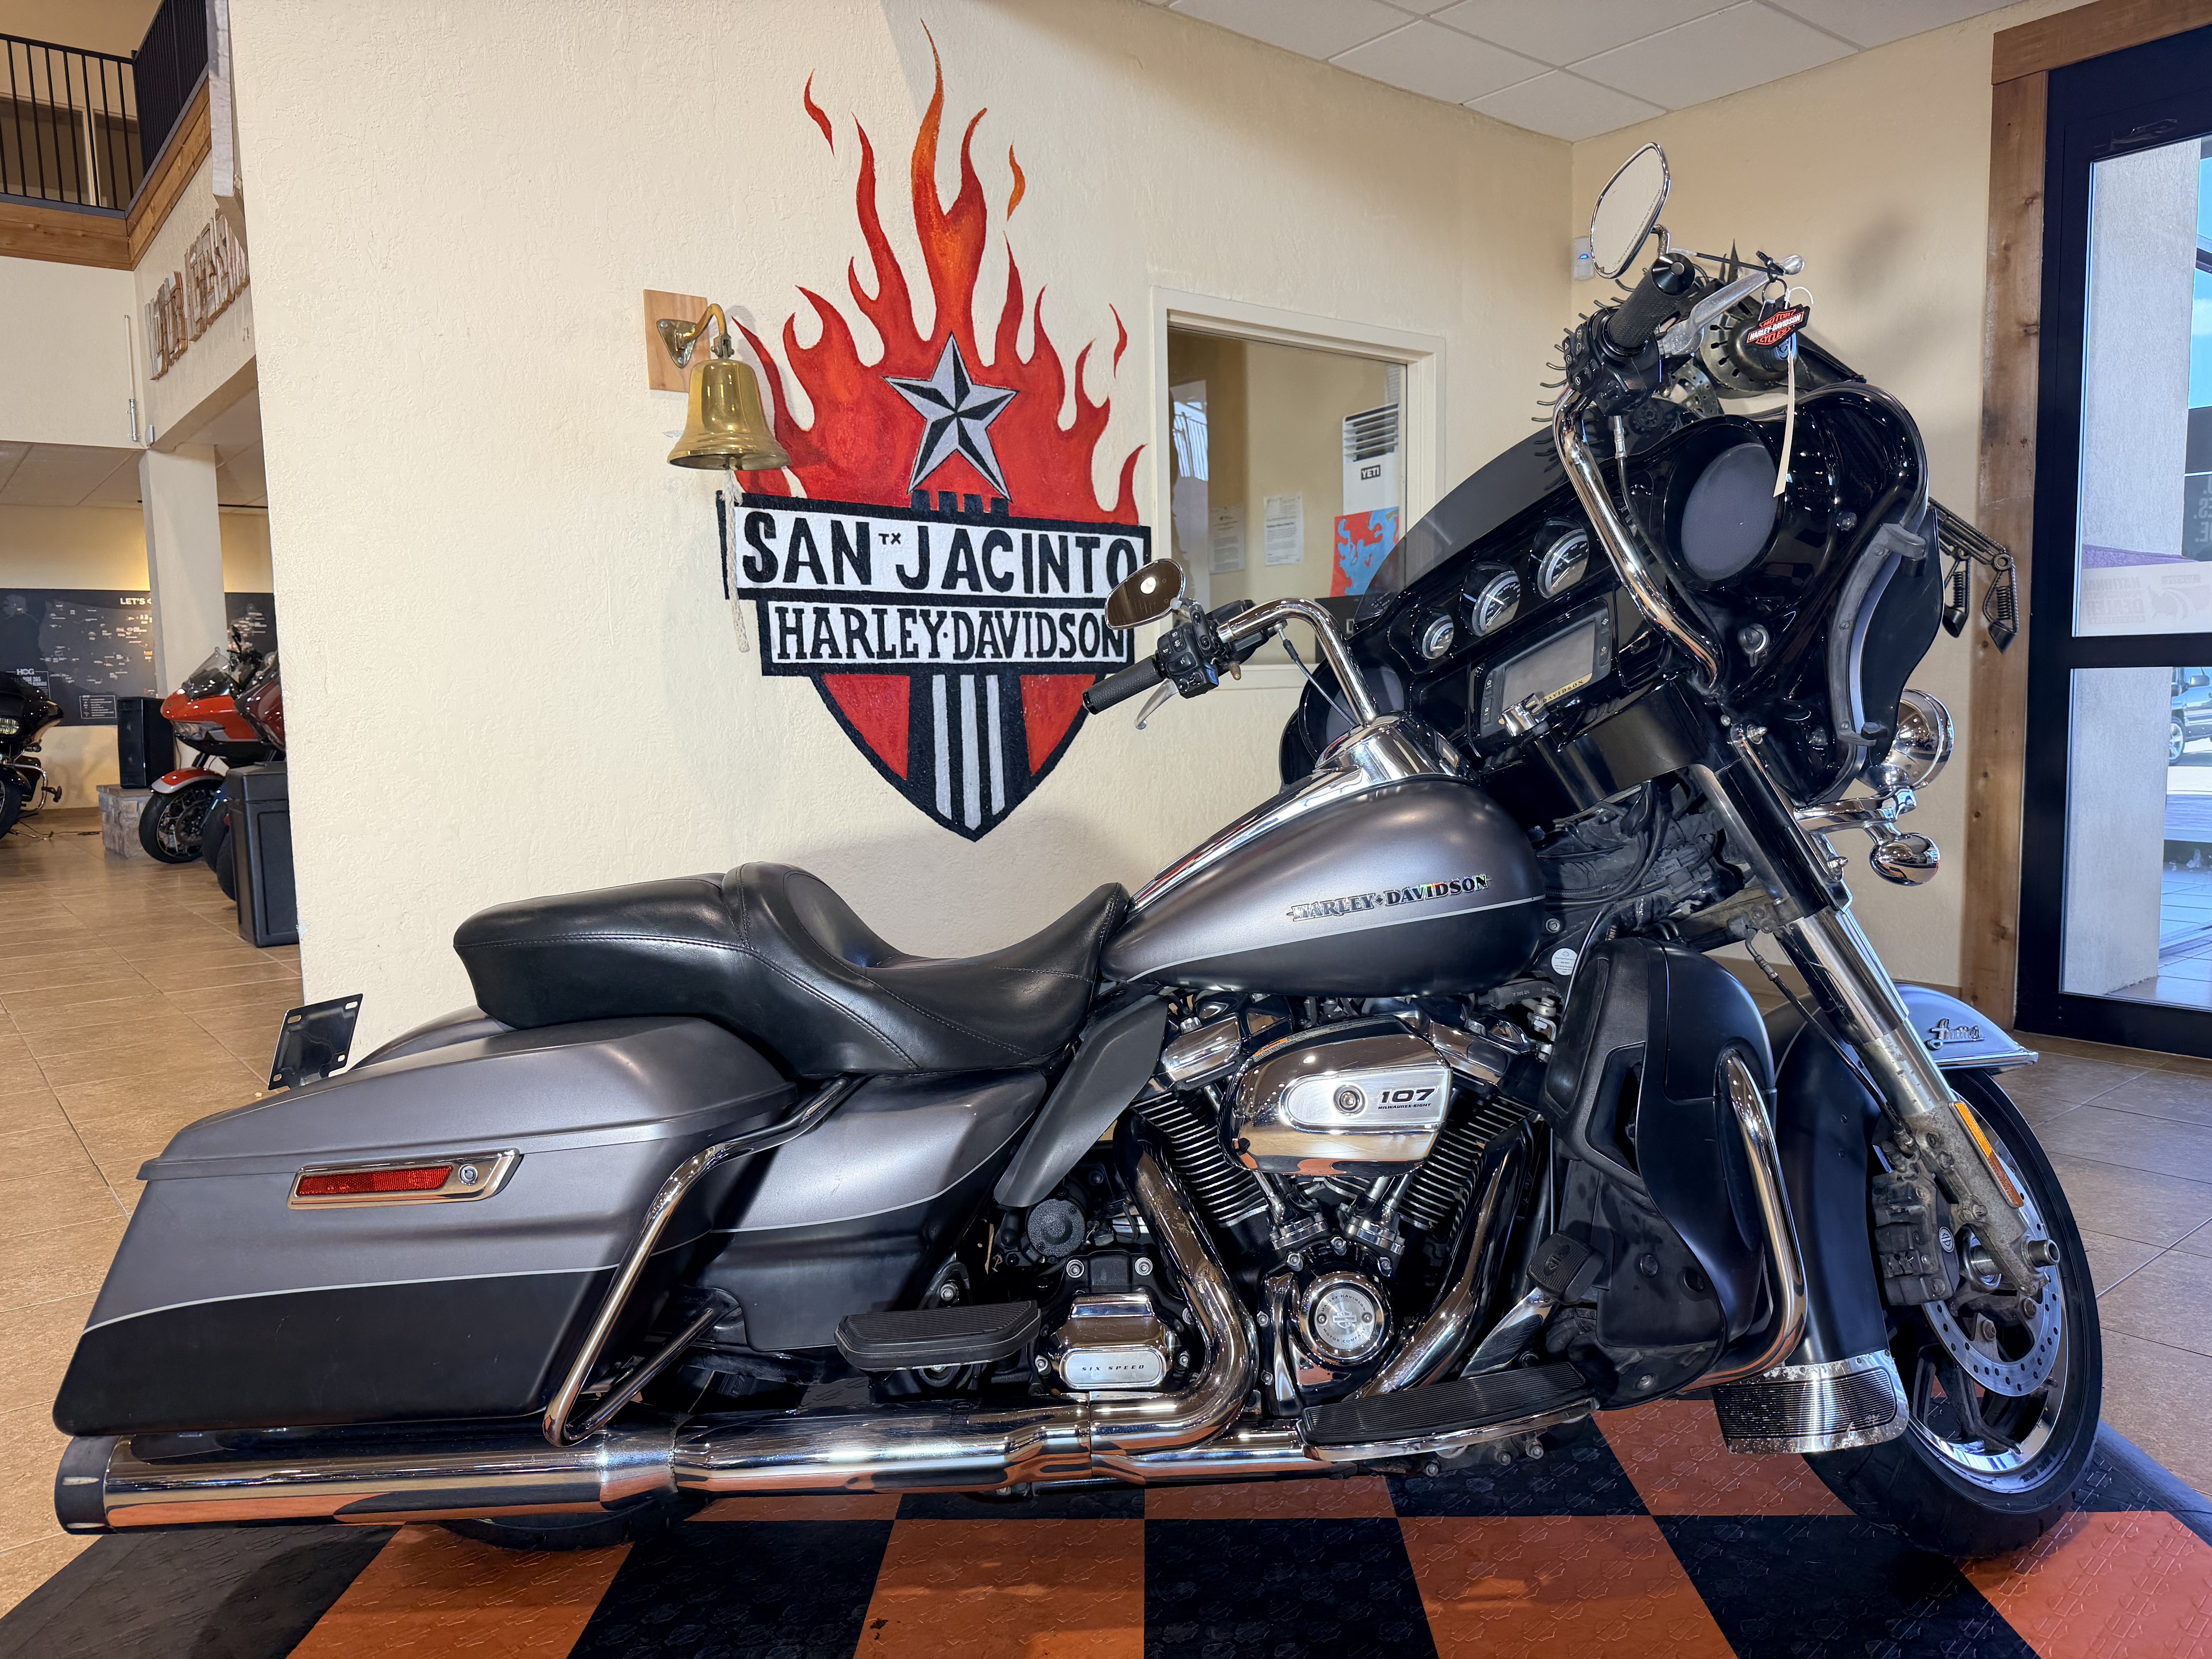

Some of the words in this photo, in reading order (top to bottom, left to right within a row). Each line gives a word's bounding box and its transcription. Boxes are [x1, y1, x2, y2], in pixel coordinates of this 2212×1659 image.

[1750, 314, 1802, 341] HARLEY-DAVIDSON
[1763, 311, 1791, 326] MOTOR
[1758, 328, 1788, 344] CYCLES
[1362, 467, 1379, 478] YETI
[742, 511, 871, 586] SAN
[879, 532, 902, 545] TX
[896, 526, 1137, 595] JACINTO
[1542, 680, 1584, 703] DAVIDSON
[1379, 1086, 1438, 1104] 107
[1322, 1294, 1366, 1312] HARLEY-DAVIDSON
[1323, 1328, 1340, 1342] MOTOR
[1342, 1327, 1366, 1343] COMPANY
